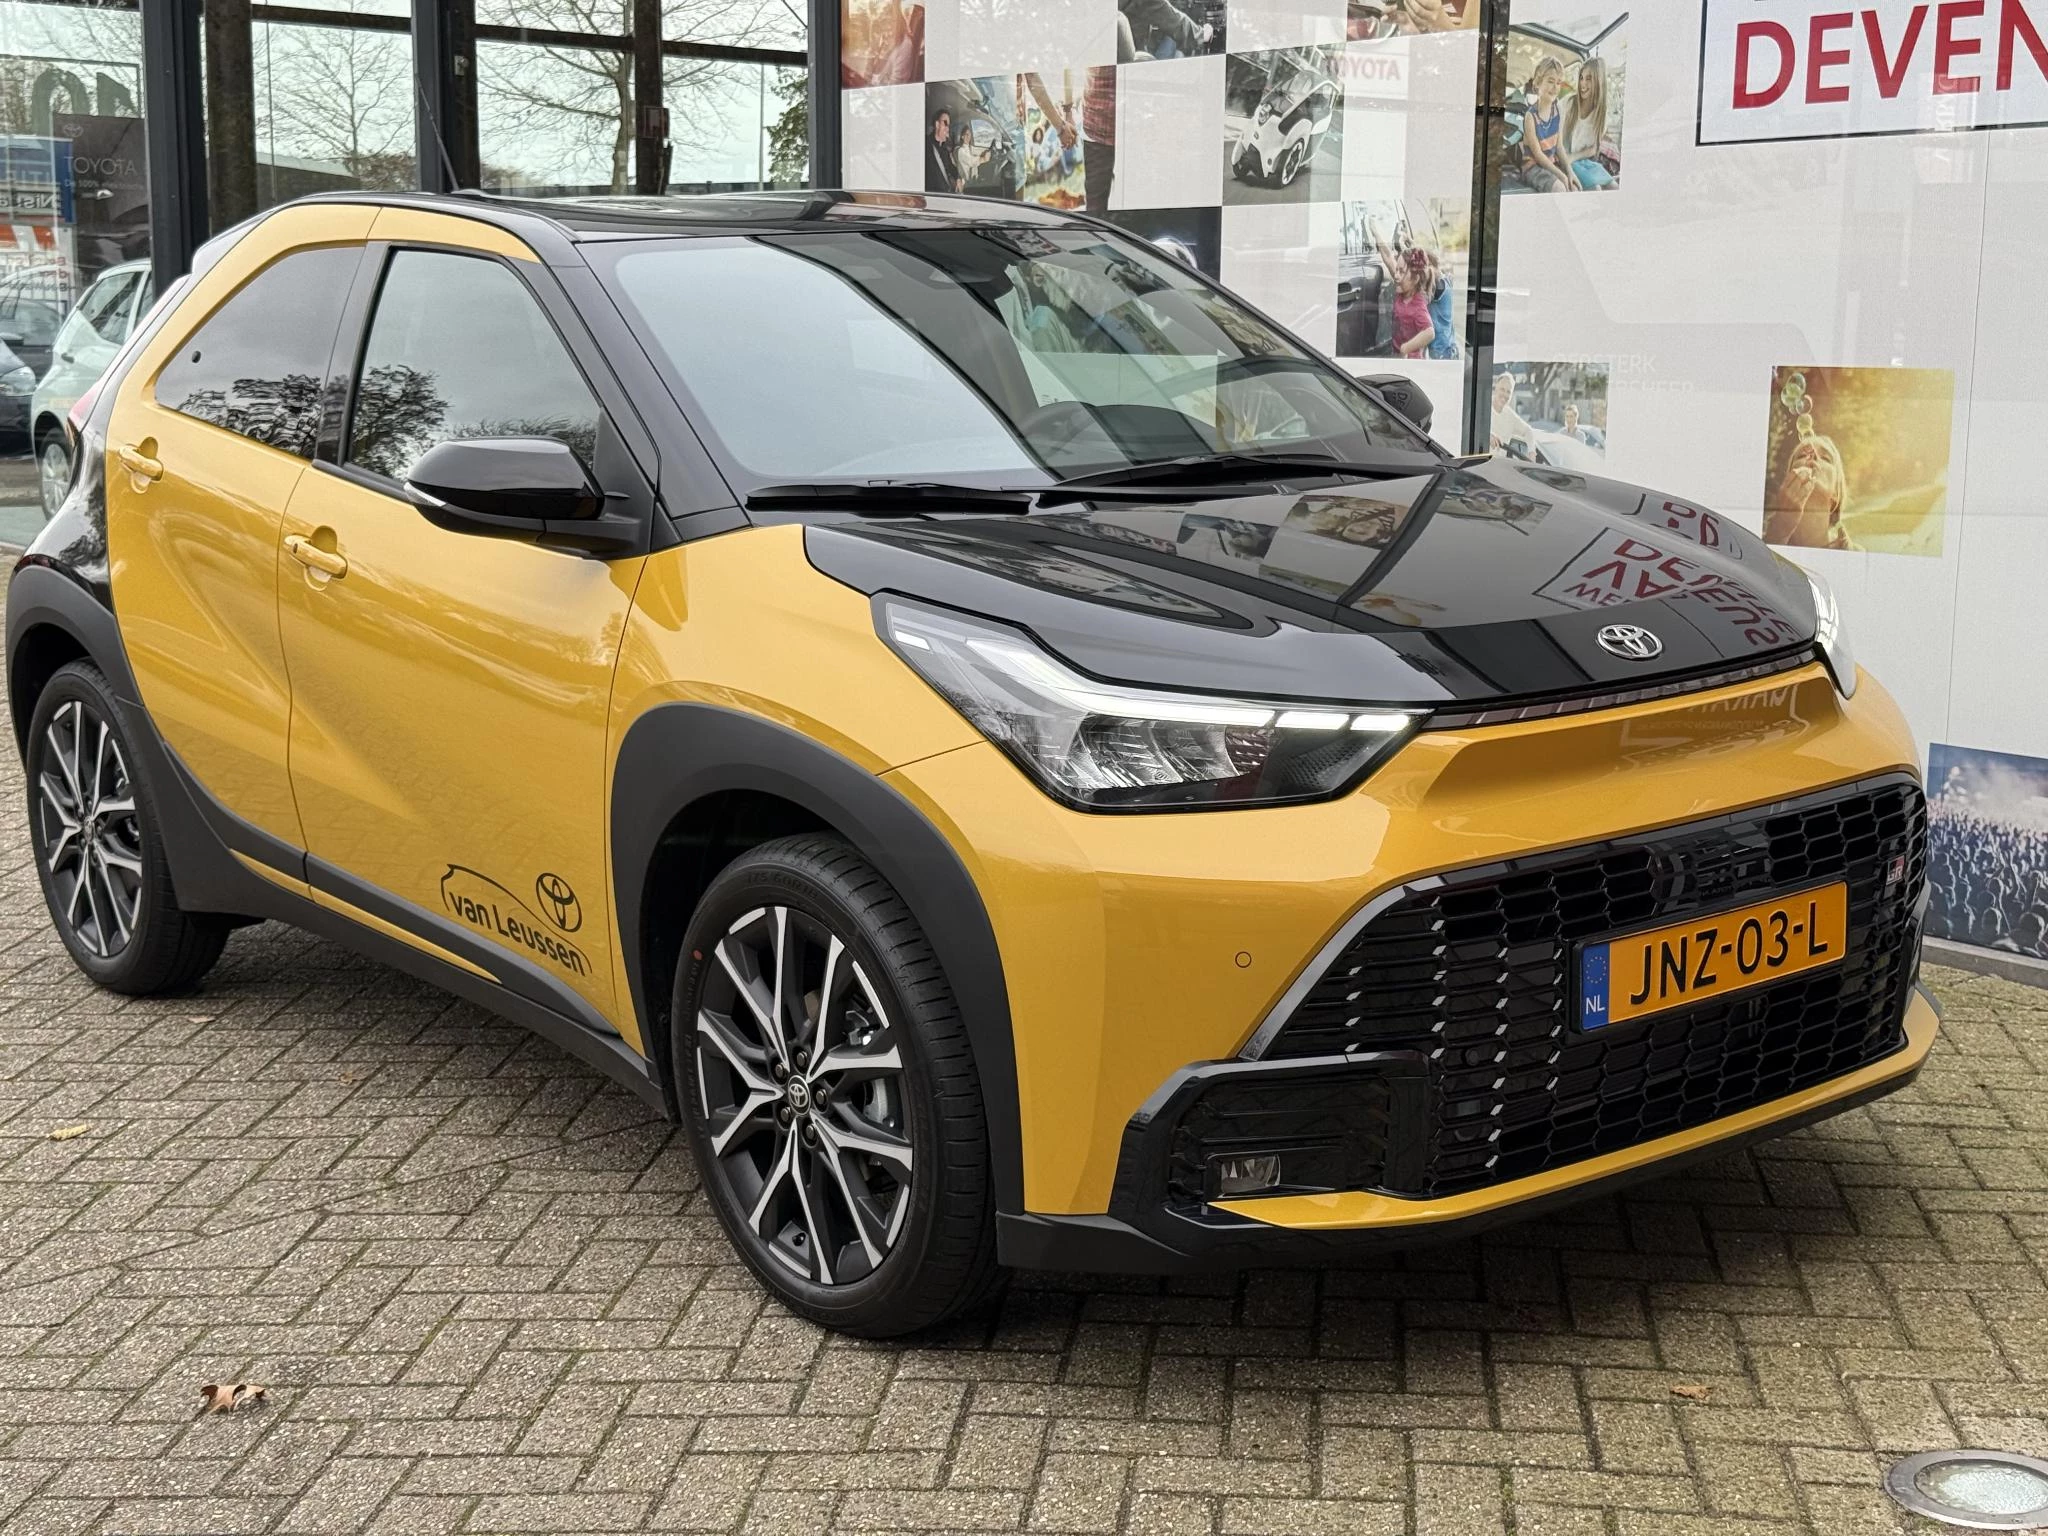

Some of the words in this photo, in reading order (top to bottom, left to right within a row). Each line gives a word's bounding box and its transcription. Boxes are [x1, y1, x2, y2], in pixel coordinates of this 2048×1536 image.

[64, 156, 137, 175] TOYOTA
[449, 891, 492, 930] van
[492, 904, 586, 976] Leussen
[1630, 901, 1829, 1005] JNZ-03-L
[1586, 995, 1605, 1015] NL
